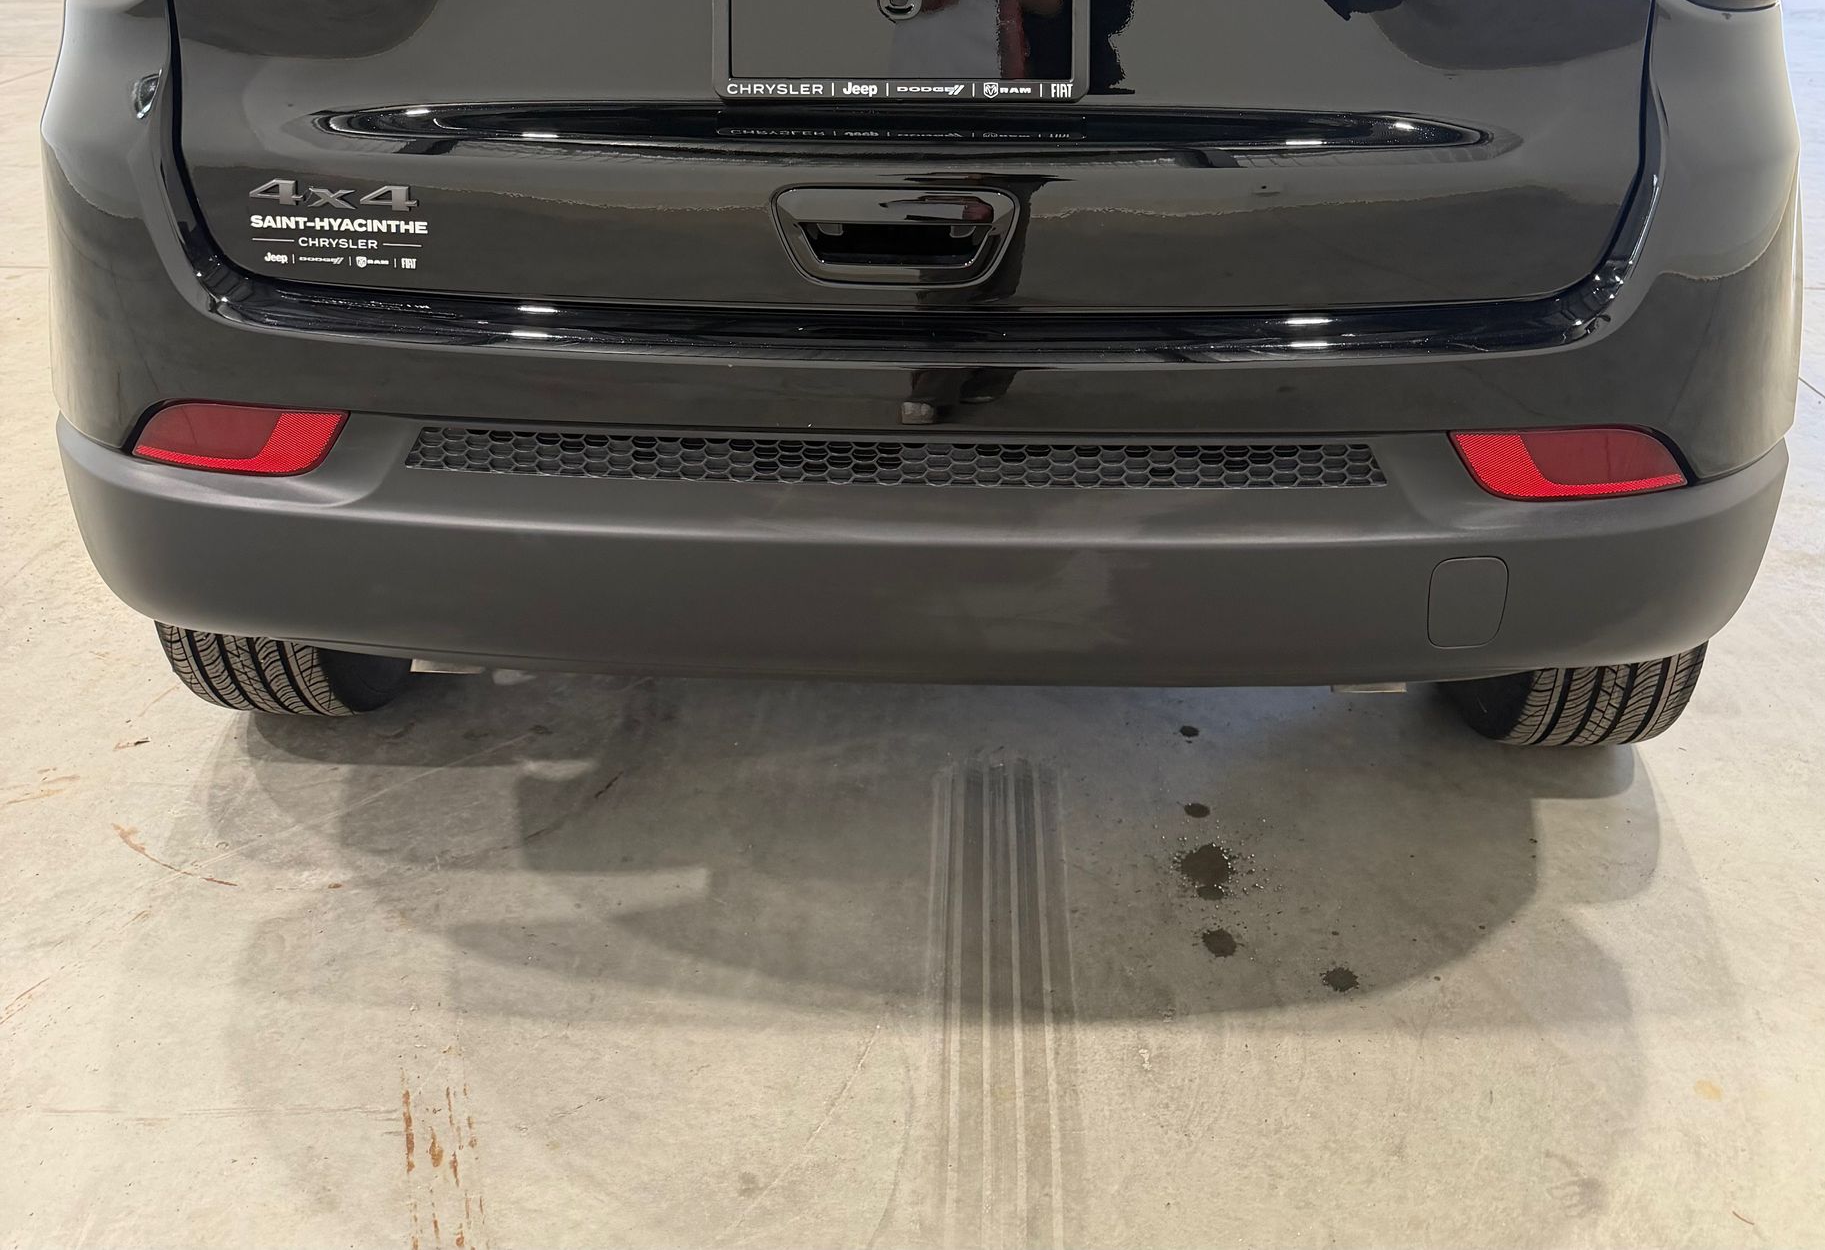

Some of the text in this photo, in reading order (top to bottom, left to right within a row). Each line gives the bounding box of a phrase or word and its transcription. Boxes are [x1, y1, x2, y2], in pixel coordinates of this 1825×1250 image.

[727, 82, 1073, 98] CHRYSLER Jeep DODGE RAM FIAT
[249, 178, 418, 212] 4x4
[250, 214, 429, 235] SAINT-HYACINTHE
[298, 236, 379, 250] CHRYSLER
[264, 252, 289, 264] Jeep
[367, 258, 390, 266] RAM
[401, 257, 417, 270] FIAT
